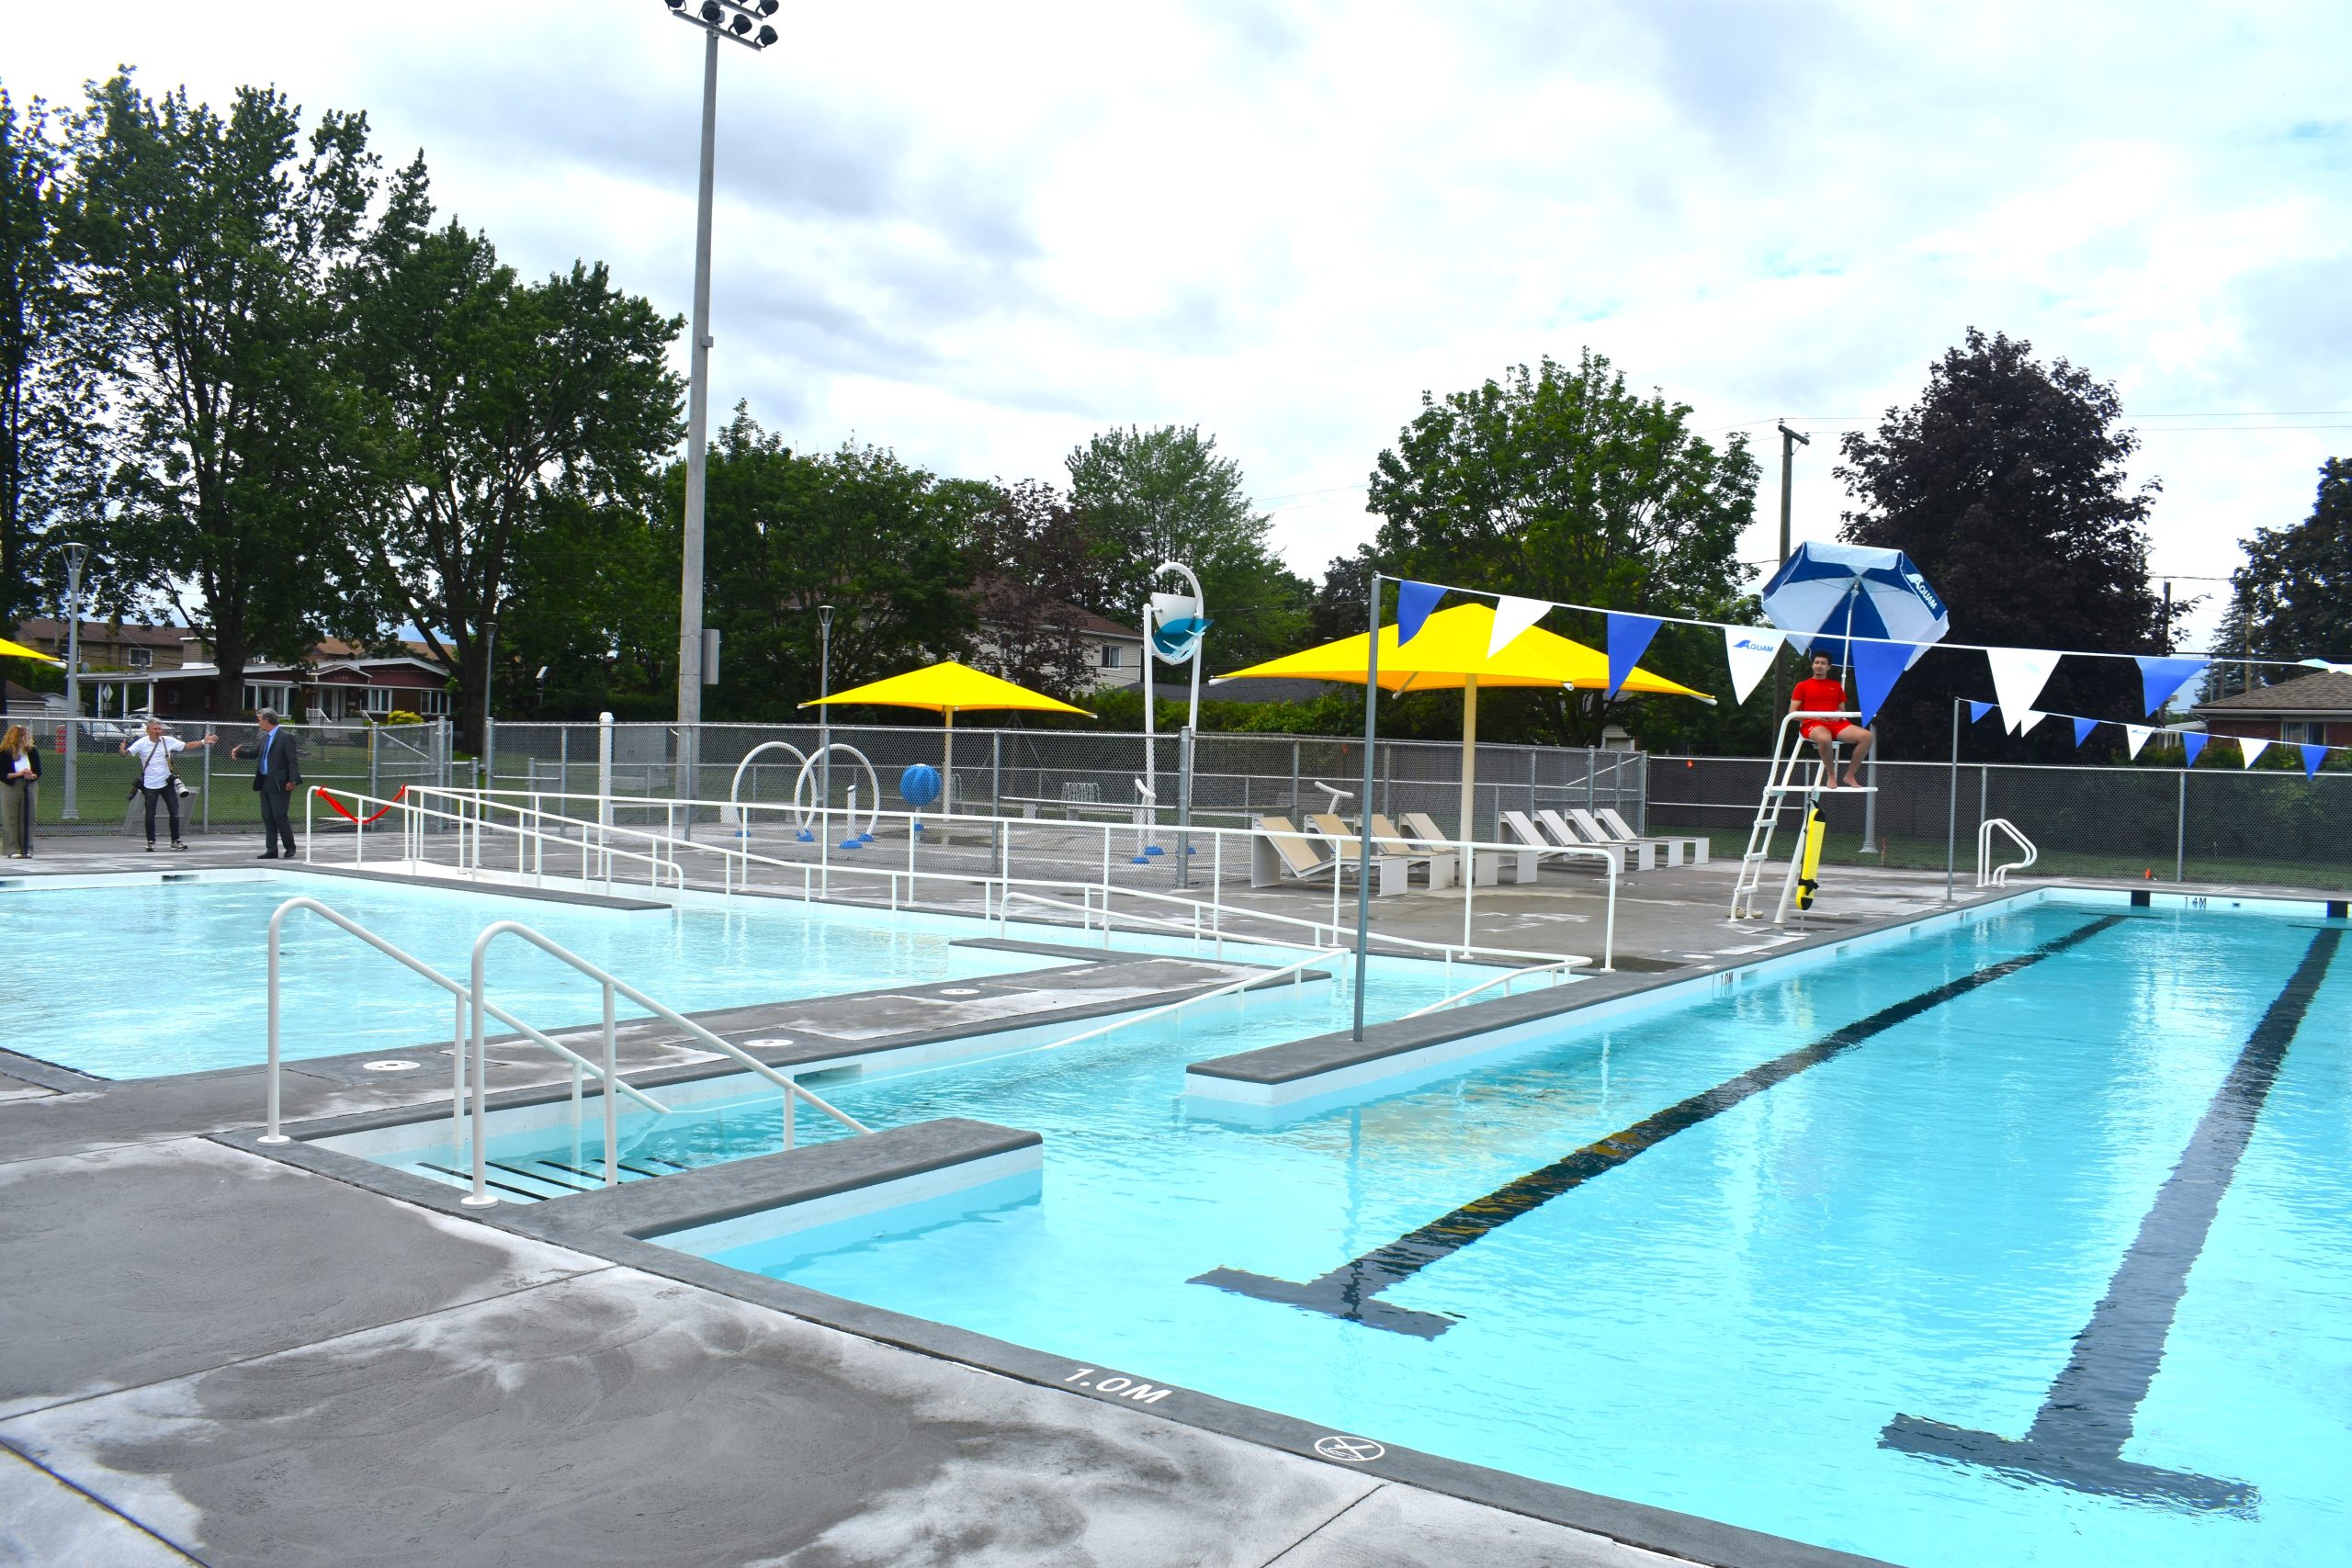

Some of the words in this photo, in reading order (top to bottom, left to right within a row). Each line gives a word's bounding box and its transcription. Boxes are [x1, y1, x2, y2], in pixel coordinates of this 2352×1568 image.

[1905, 573, 1938, 610] AQUAM
[1733, 639, 1774, 653] AQUAM
[1064, 1368, 1172, 1404] 1.0M
